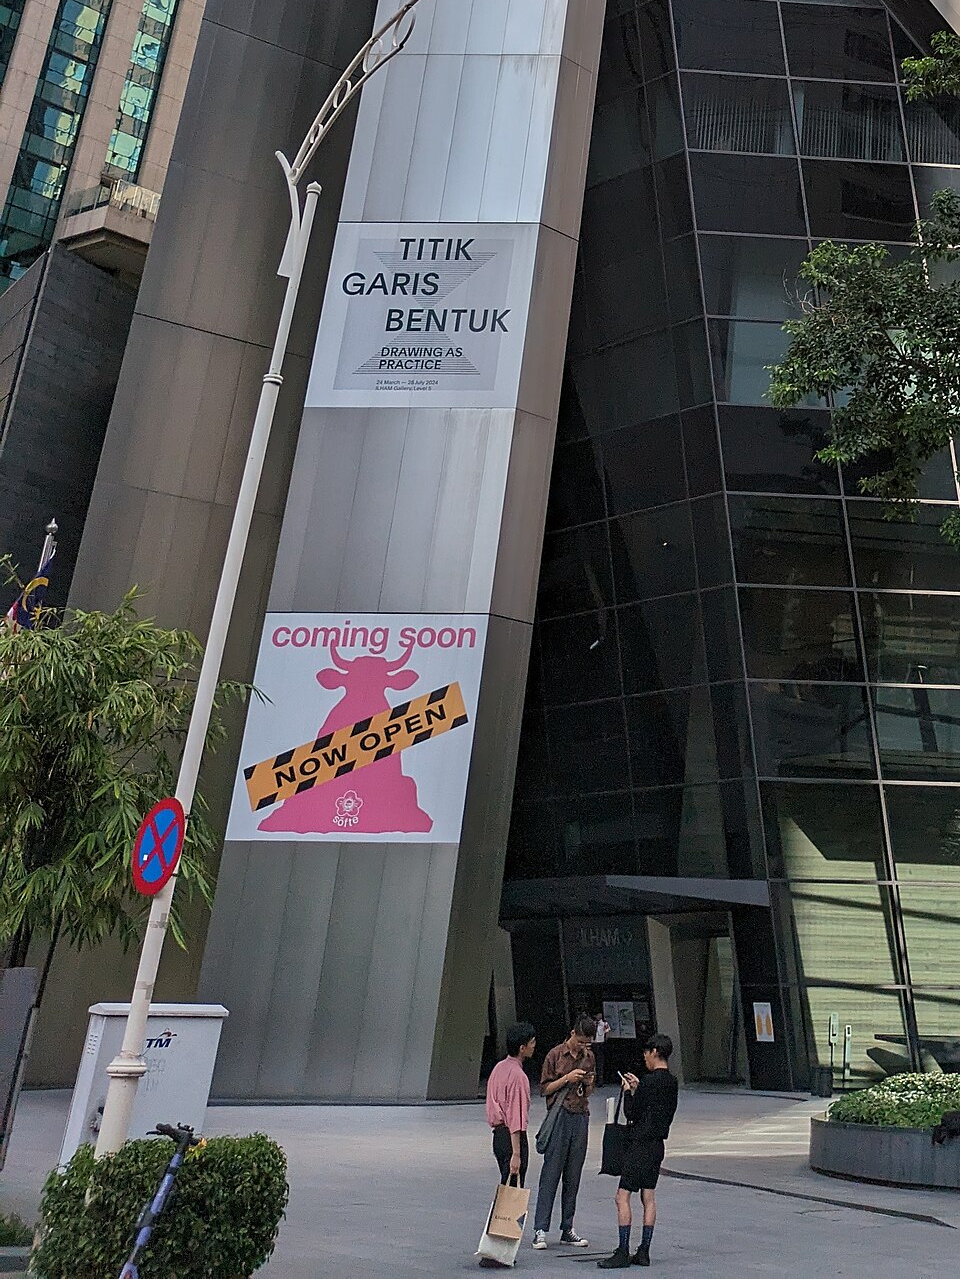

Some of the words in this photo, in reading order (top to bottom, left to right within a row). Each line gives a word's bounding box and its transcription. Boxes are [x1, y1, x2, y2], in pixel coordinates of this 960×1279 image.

[400, 238, 475, 261] TITIK
[342, 272, 440, 296] GARIS
[385, 308, 512, 333] BENTUK
[381, 347, 443, 357] DRAWING
[445, 347, 463, 357] AS
[378, 359, 442, 370] PRACTICE
[272, 620, 390, 654] coming
[398, 626, 477, 648] soon
[274, 744, 348, 789] NOW
[359, 704, 446, 752] OPEN
[146, 1038, 172, 1049] TM
